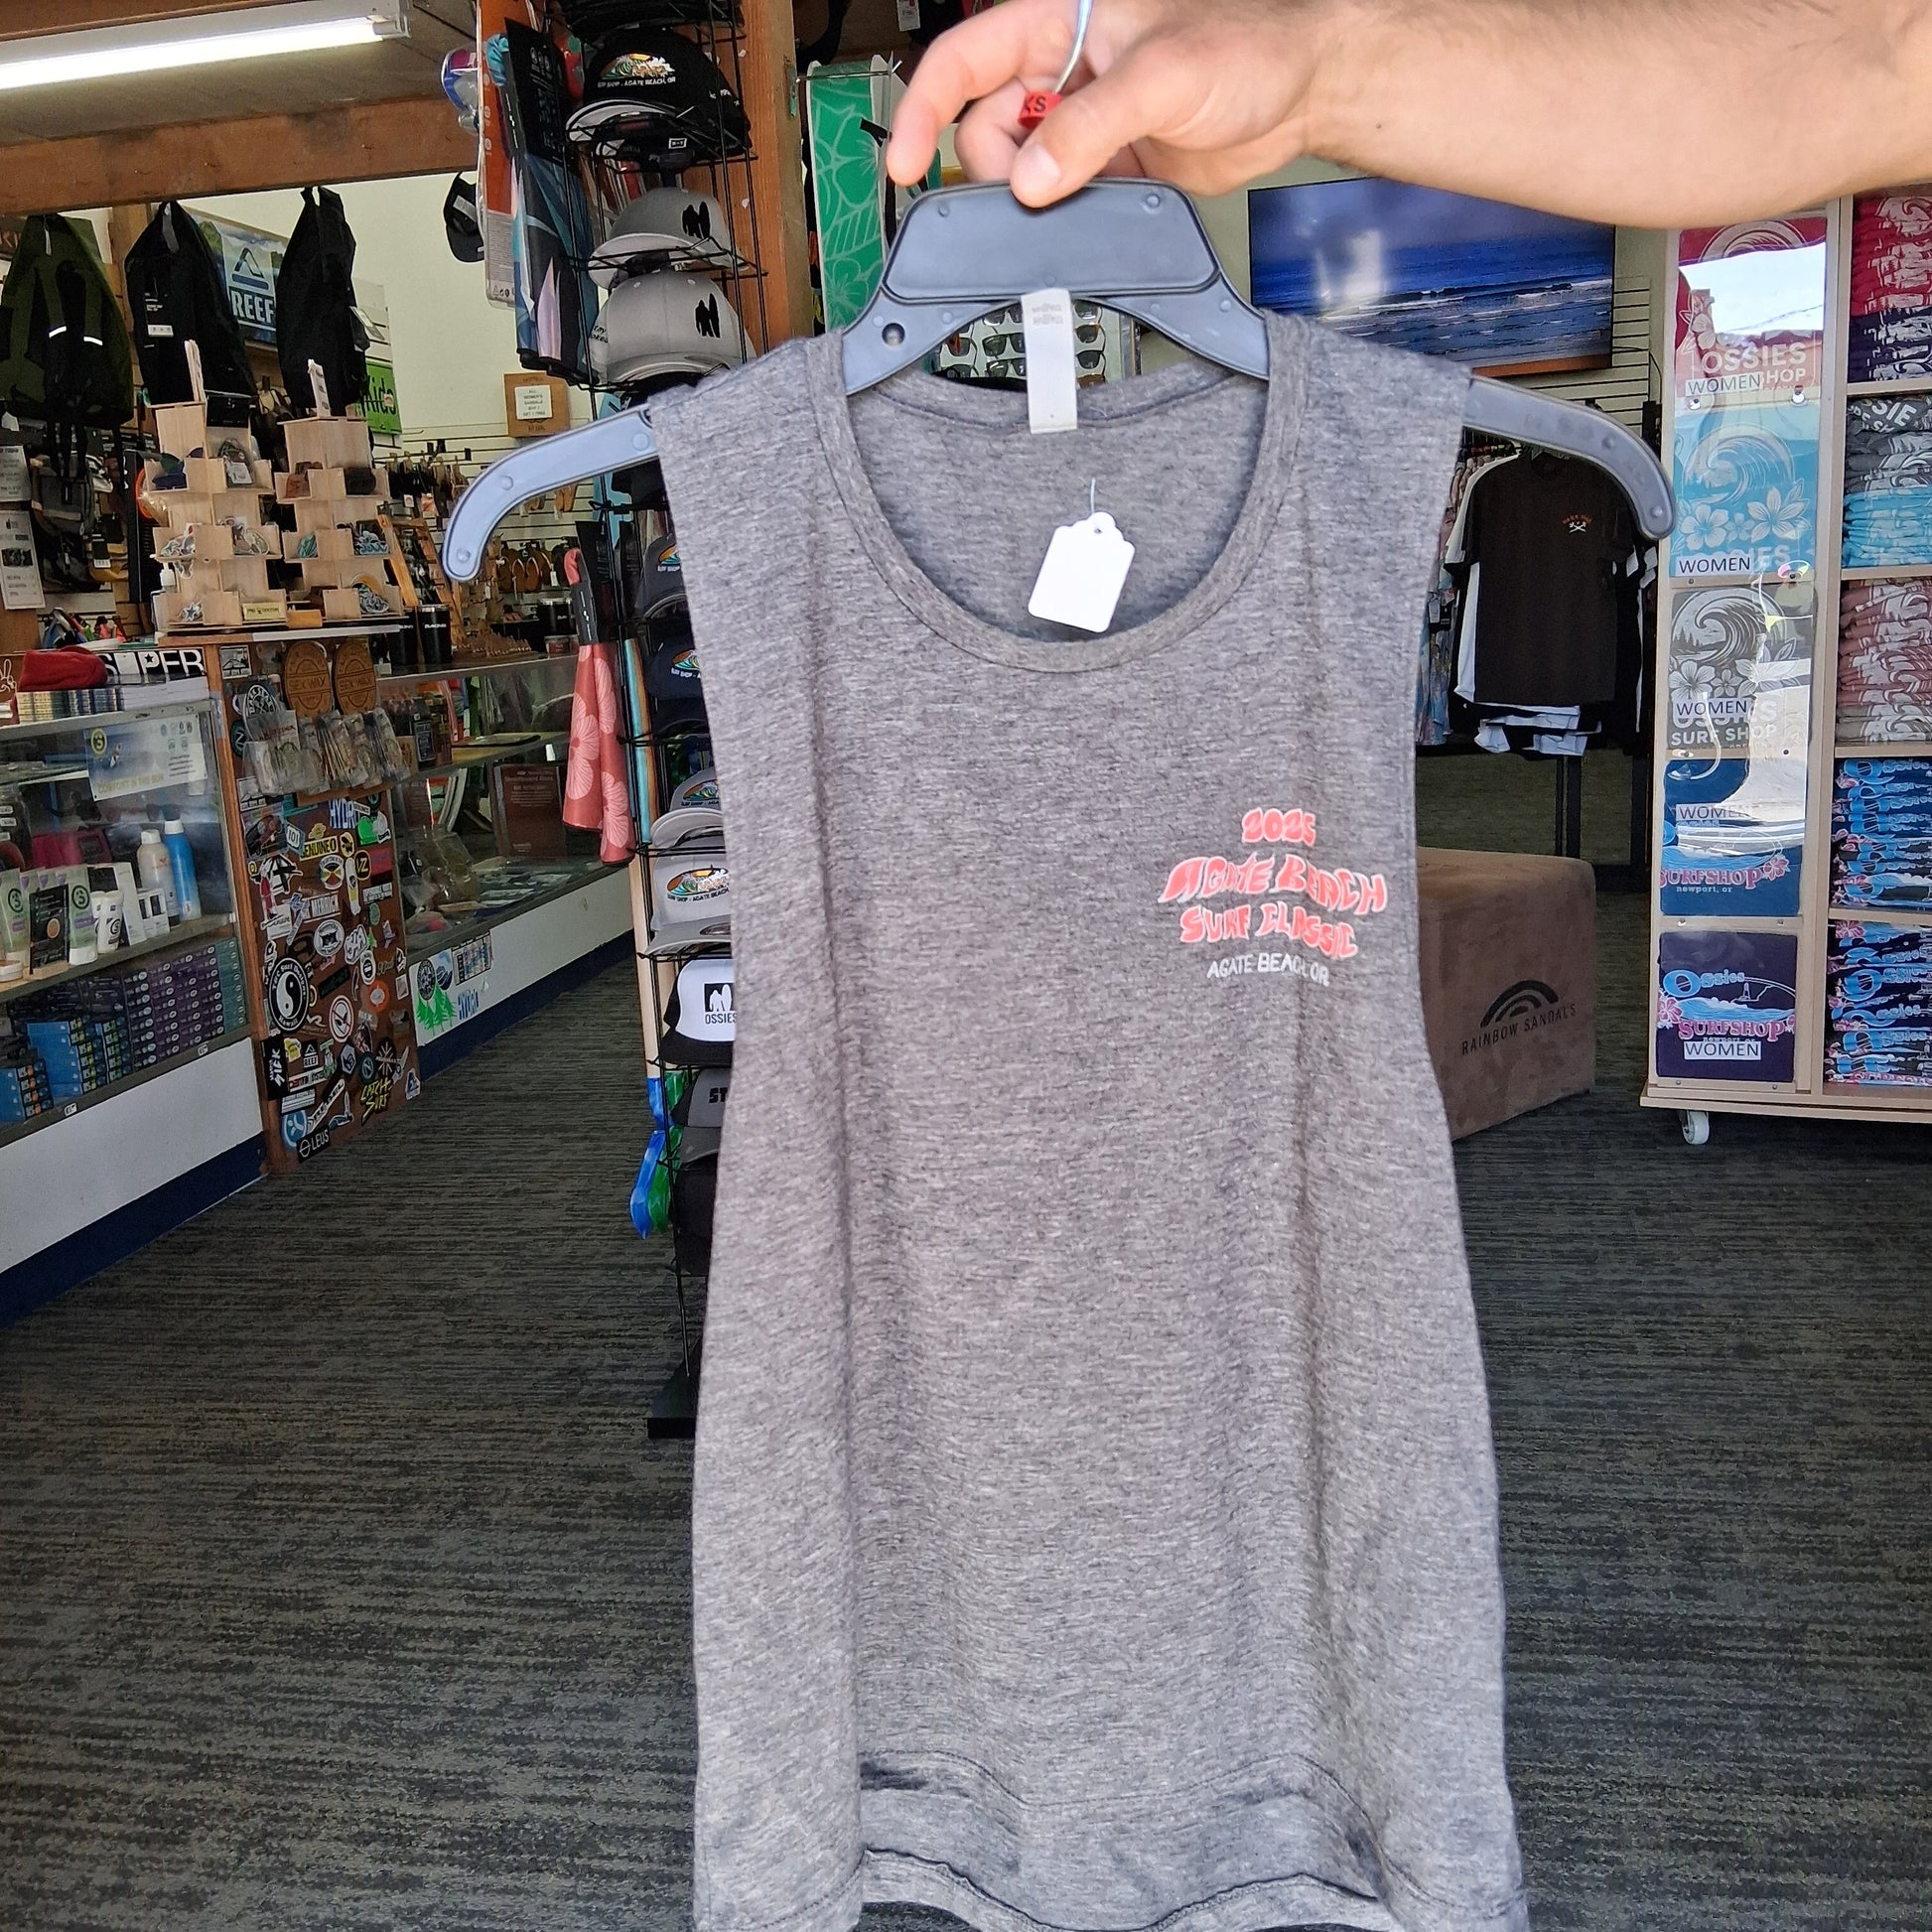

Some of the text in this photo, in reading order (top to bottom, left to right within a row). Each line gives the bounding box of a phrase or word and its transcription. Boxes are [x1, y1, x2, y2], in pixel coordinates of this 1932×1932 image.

[230, 288, 276, 325] REEF
[1701, 342, 1807, 374] OSSIES
[1687, 373, 1761, 395] WOMEN
[1760, 367, 1807, 386] HOP
[1679, 556, 1751, 574] WOMEN
[1677, 700, 1747, 716] WOMEN
[1679, 804, 1749, 820] WOMEN
[1158, 852, 1388, 915] AGATE BEACH
[1179, 901, 1359, 959] SURF CLASSIC
[1206, 954, 1254, 979] AGATE
[1663, 968, 1745, 999] Ossies
[704, 1012, 737, 1026] OSSIES
[1461, 1003, 1577, 1055] RAINBOW SANDALS
[1678, 1020, 1786, 1042] SURFSHOP
[1685, 1042, 1759, 1056] WOMEN
[303, 1054, 319, 1068] REEF
[310, 1129, 330, 1151] LEUS
